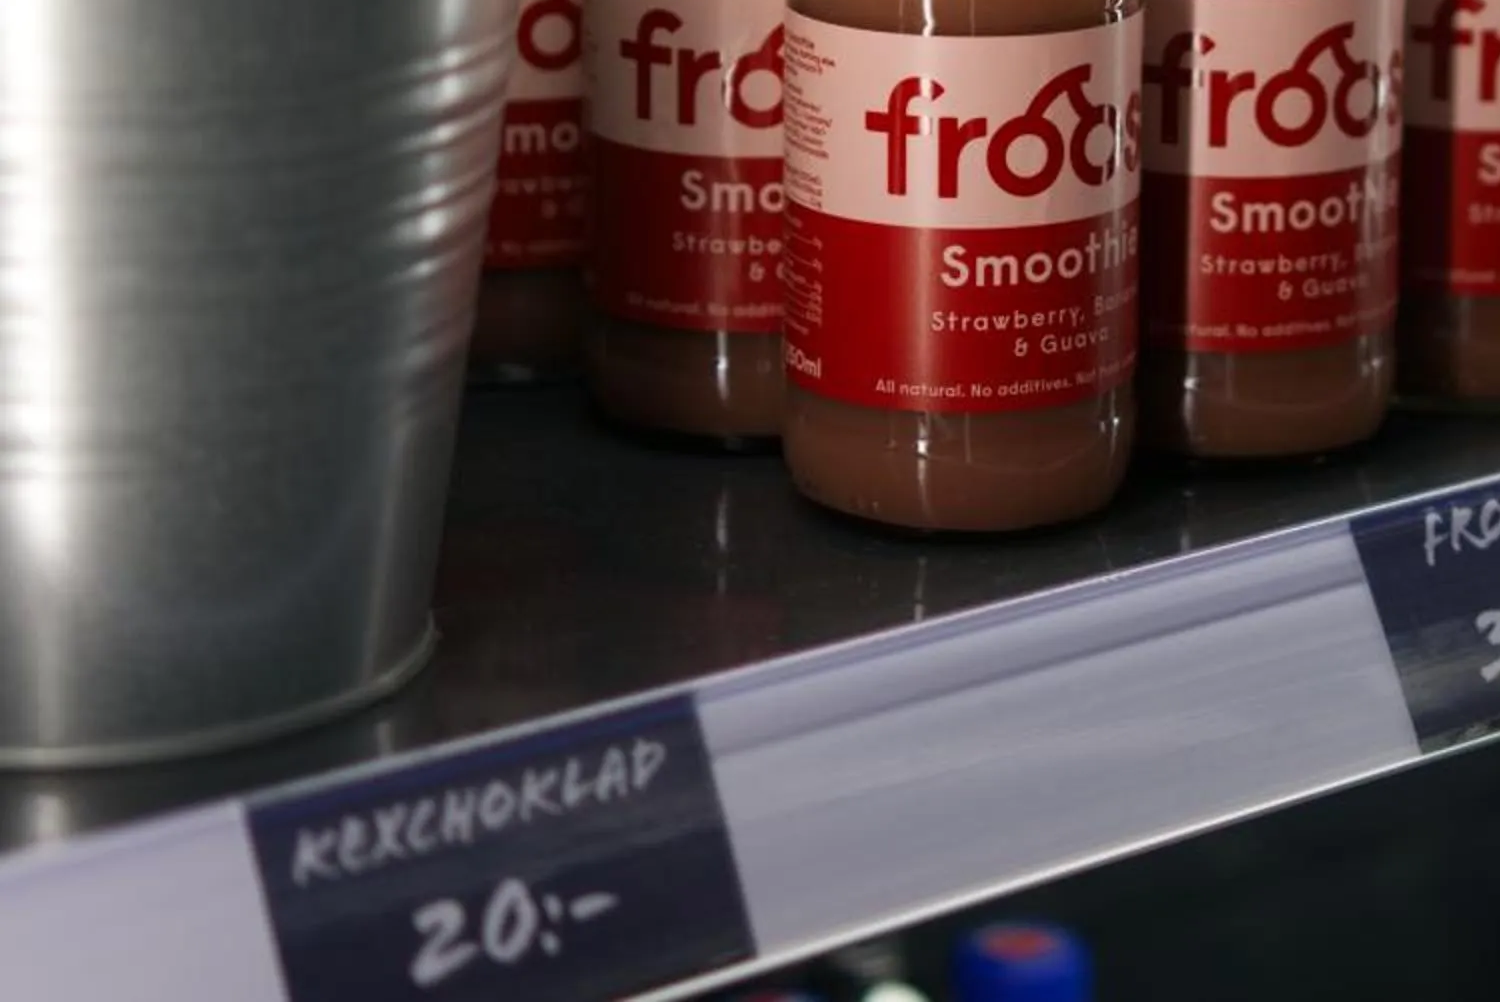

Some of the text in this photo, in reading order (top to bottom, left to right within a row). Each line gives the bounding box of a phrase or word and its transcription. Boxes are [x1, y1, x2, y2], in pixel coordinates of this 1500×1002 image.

[931, 306, 1085, 332] Strawberry,
[1014, 326, 1109, 357] & Guava
[875, 378, 895, 394] All
[900, 381, 965, 398] natural.
[970, 384, 992, 397] No
[997, 376, 1072, 397] additives.
[410, 878, 620, 988] 20:-
